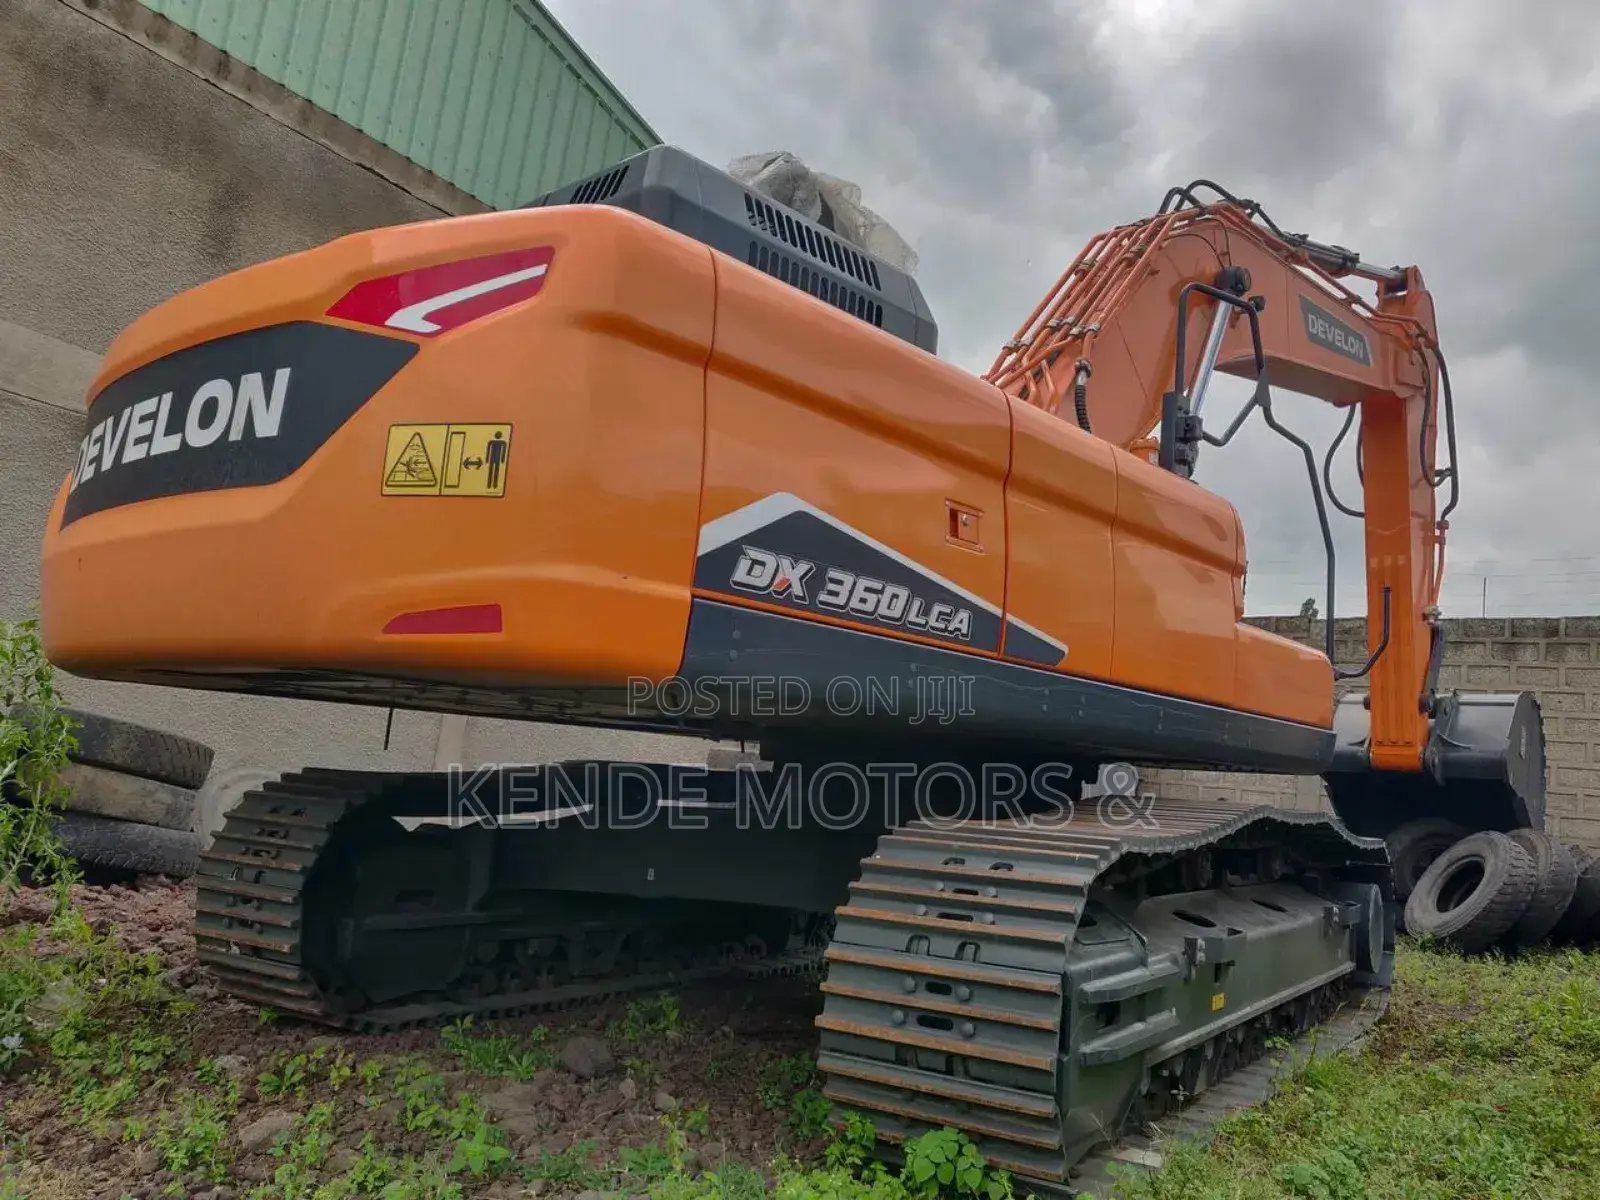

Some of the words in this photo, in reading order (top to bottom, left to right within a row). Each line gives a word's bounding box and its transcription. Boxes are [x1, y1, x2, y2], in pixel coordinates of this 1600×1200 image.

[1308, 313, 1364, 359] DEVELON
[69, 367, 291, 494] DEVELON
[730, 545, 816, 605] DX
